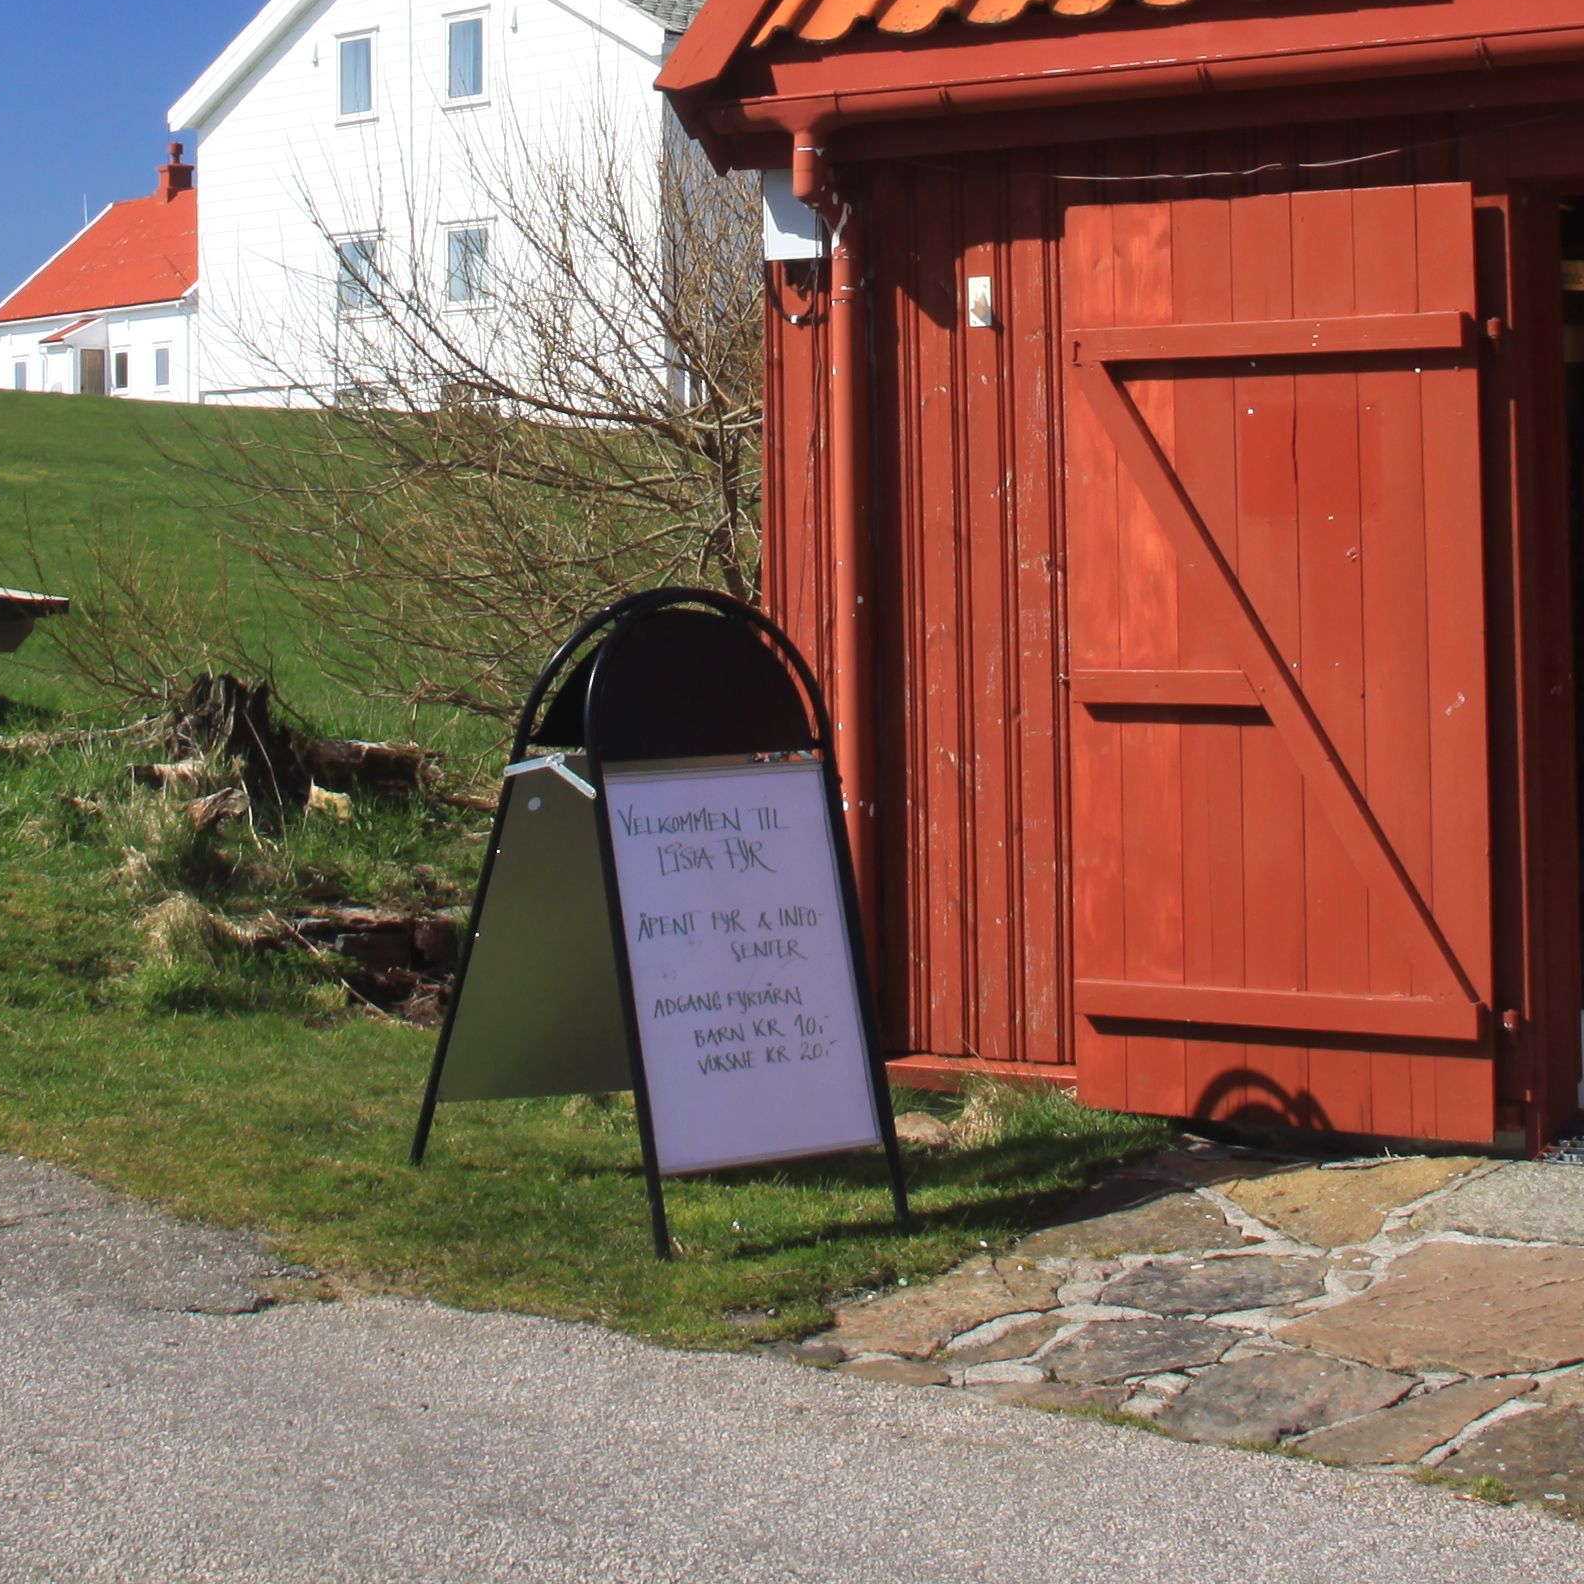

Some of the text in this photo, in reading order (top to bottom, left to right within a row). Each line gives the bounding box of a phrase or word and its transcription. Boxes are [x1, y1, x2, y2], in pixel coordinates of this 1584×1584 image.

[618, 804, 790, 837] VELKOMMEN TIL
[717, 836, 777, 873] FYR
[638, 911, 702, 942] ÅPENT
[712, 909, 747, 933] FYR
[730, 939, 809, 963] SENTER
[653, 991, 722, 1019] ADGANG
[693, 1023, 746, 1048] BARN
[752, 1018, 785, 1038] KR
[698, 1049, 756, 1076] VOKSNE
[766, 1045, 791, 1063] KR
